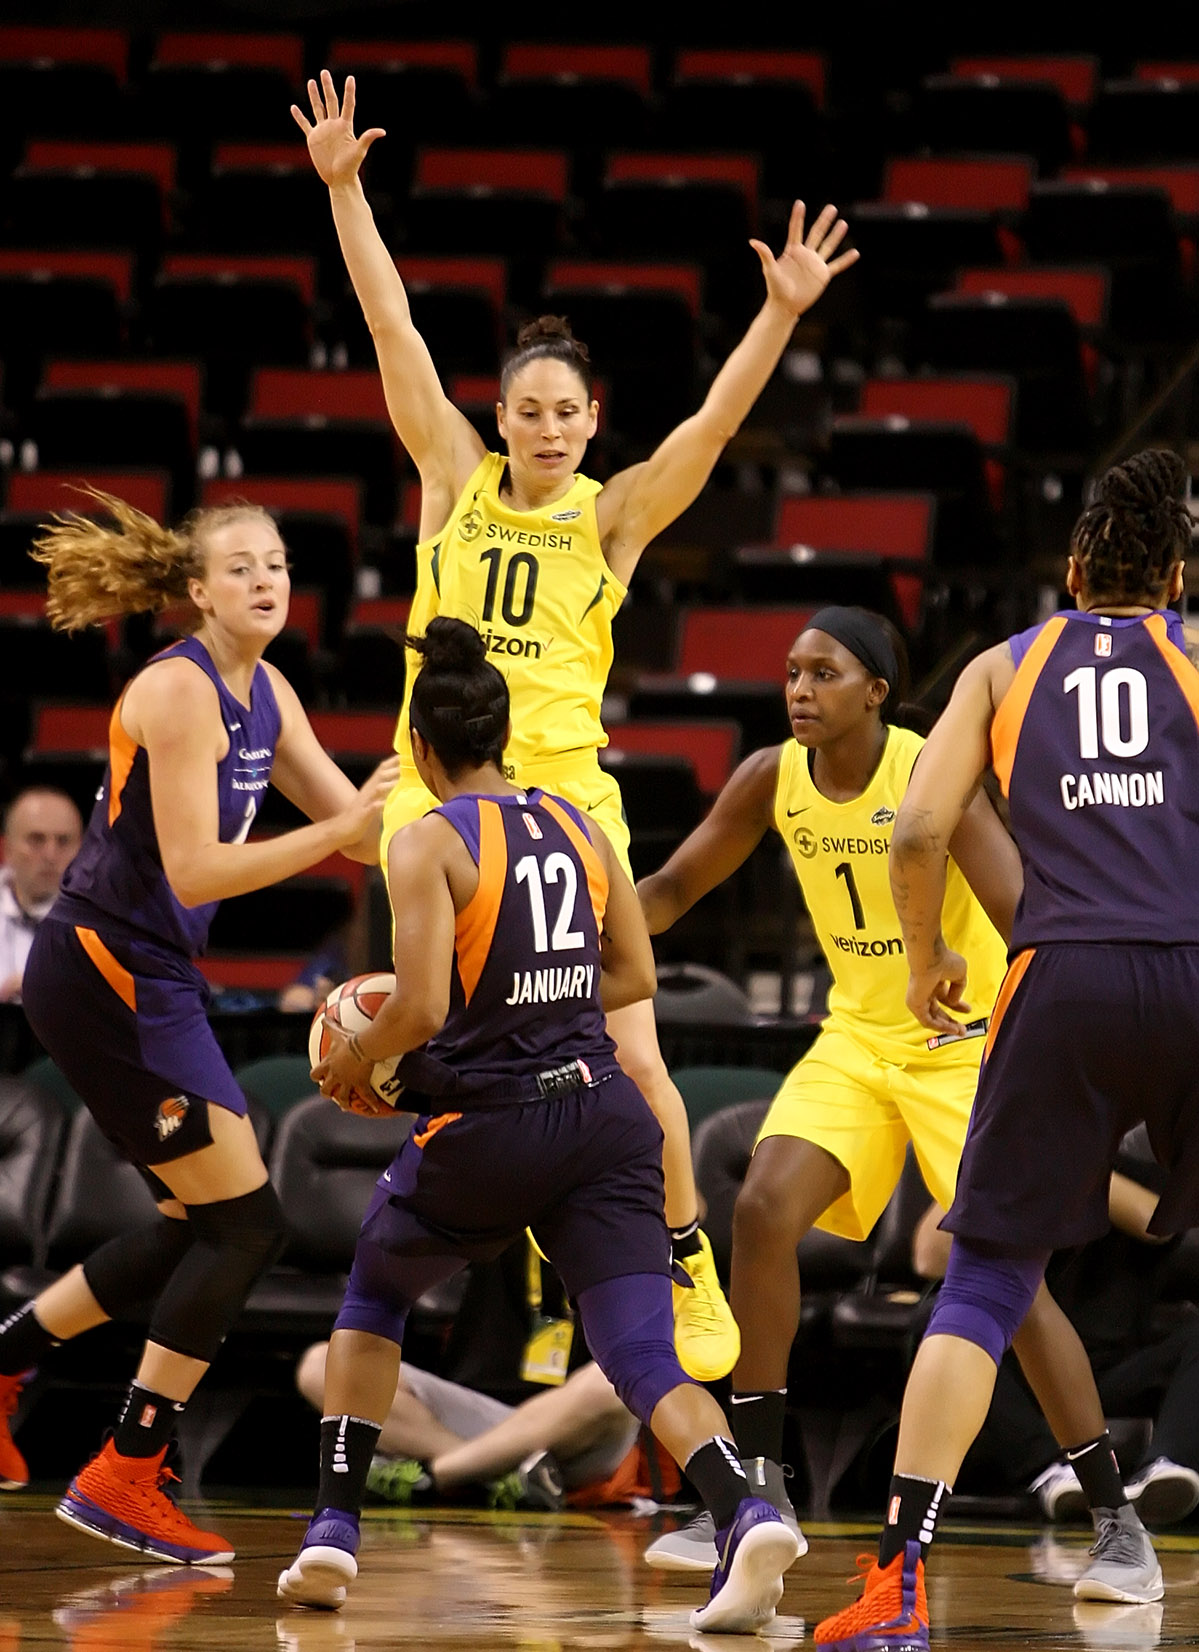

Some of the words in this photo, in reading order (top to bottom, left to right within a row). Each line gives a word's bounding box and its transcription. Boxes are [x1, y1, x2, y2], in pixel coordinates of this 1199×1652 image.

[486, 524, 572, 550] SWEDISH
[480, 547, 539, 627] 10
[480, 628, 541, 659] izon
[1063, 666, 1149, 759] 10
[1060, 771, 1164, 810] CANNON
[515, 852, 585, 953] 12
[835, 862, 866, 930] 1
[830, 933, 904, 957] verizon
[505, 964, 594, 1006] JANUARY
